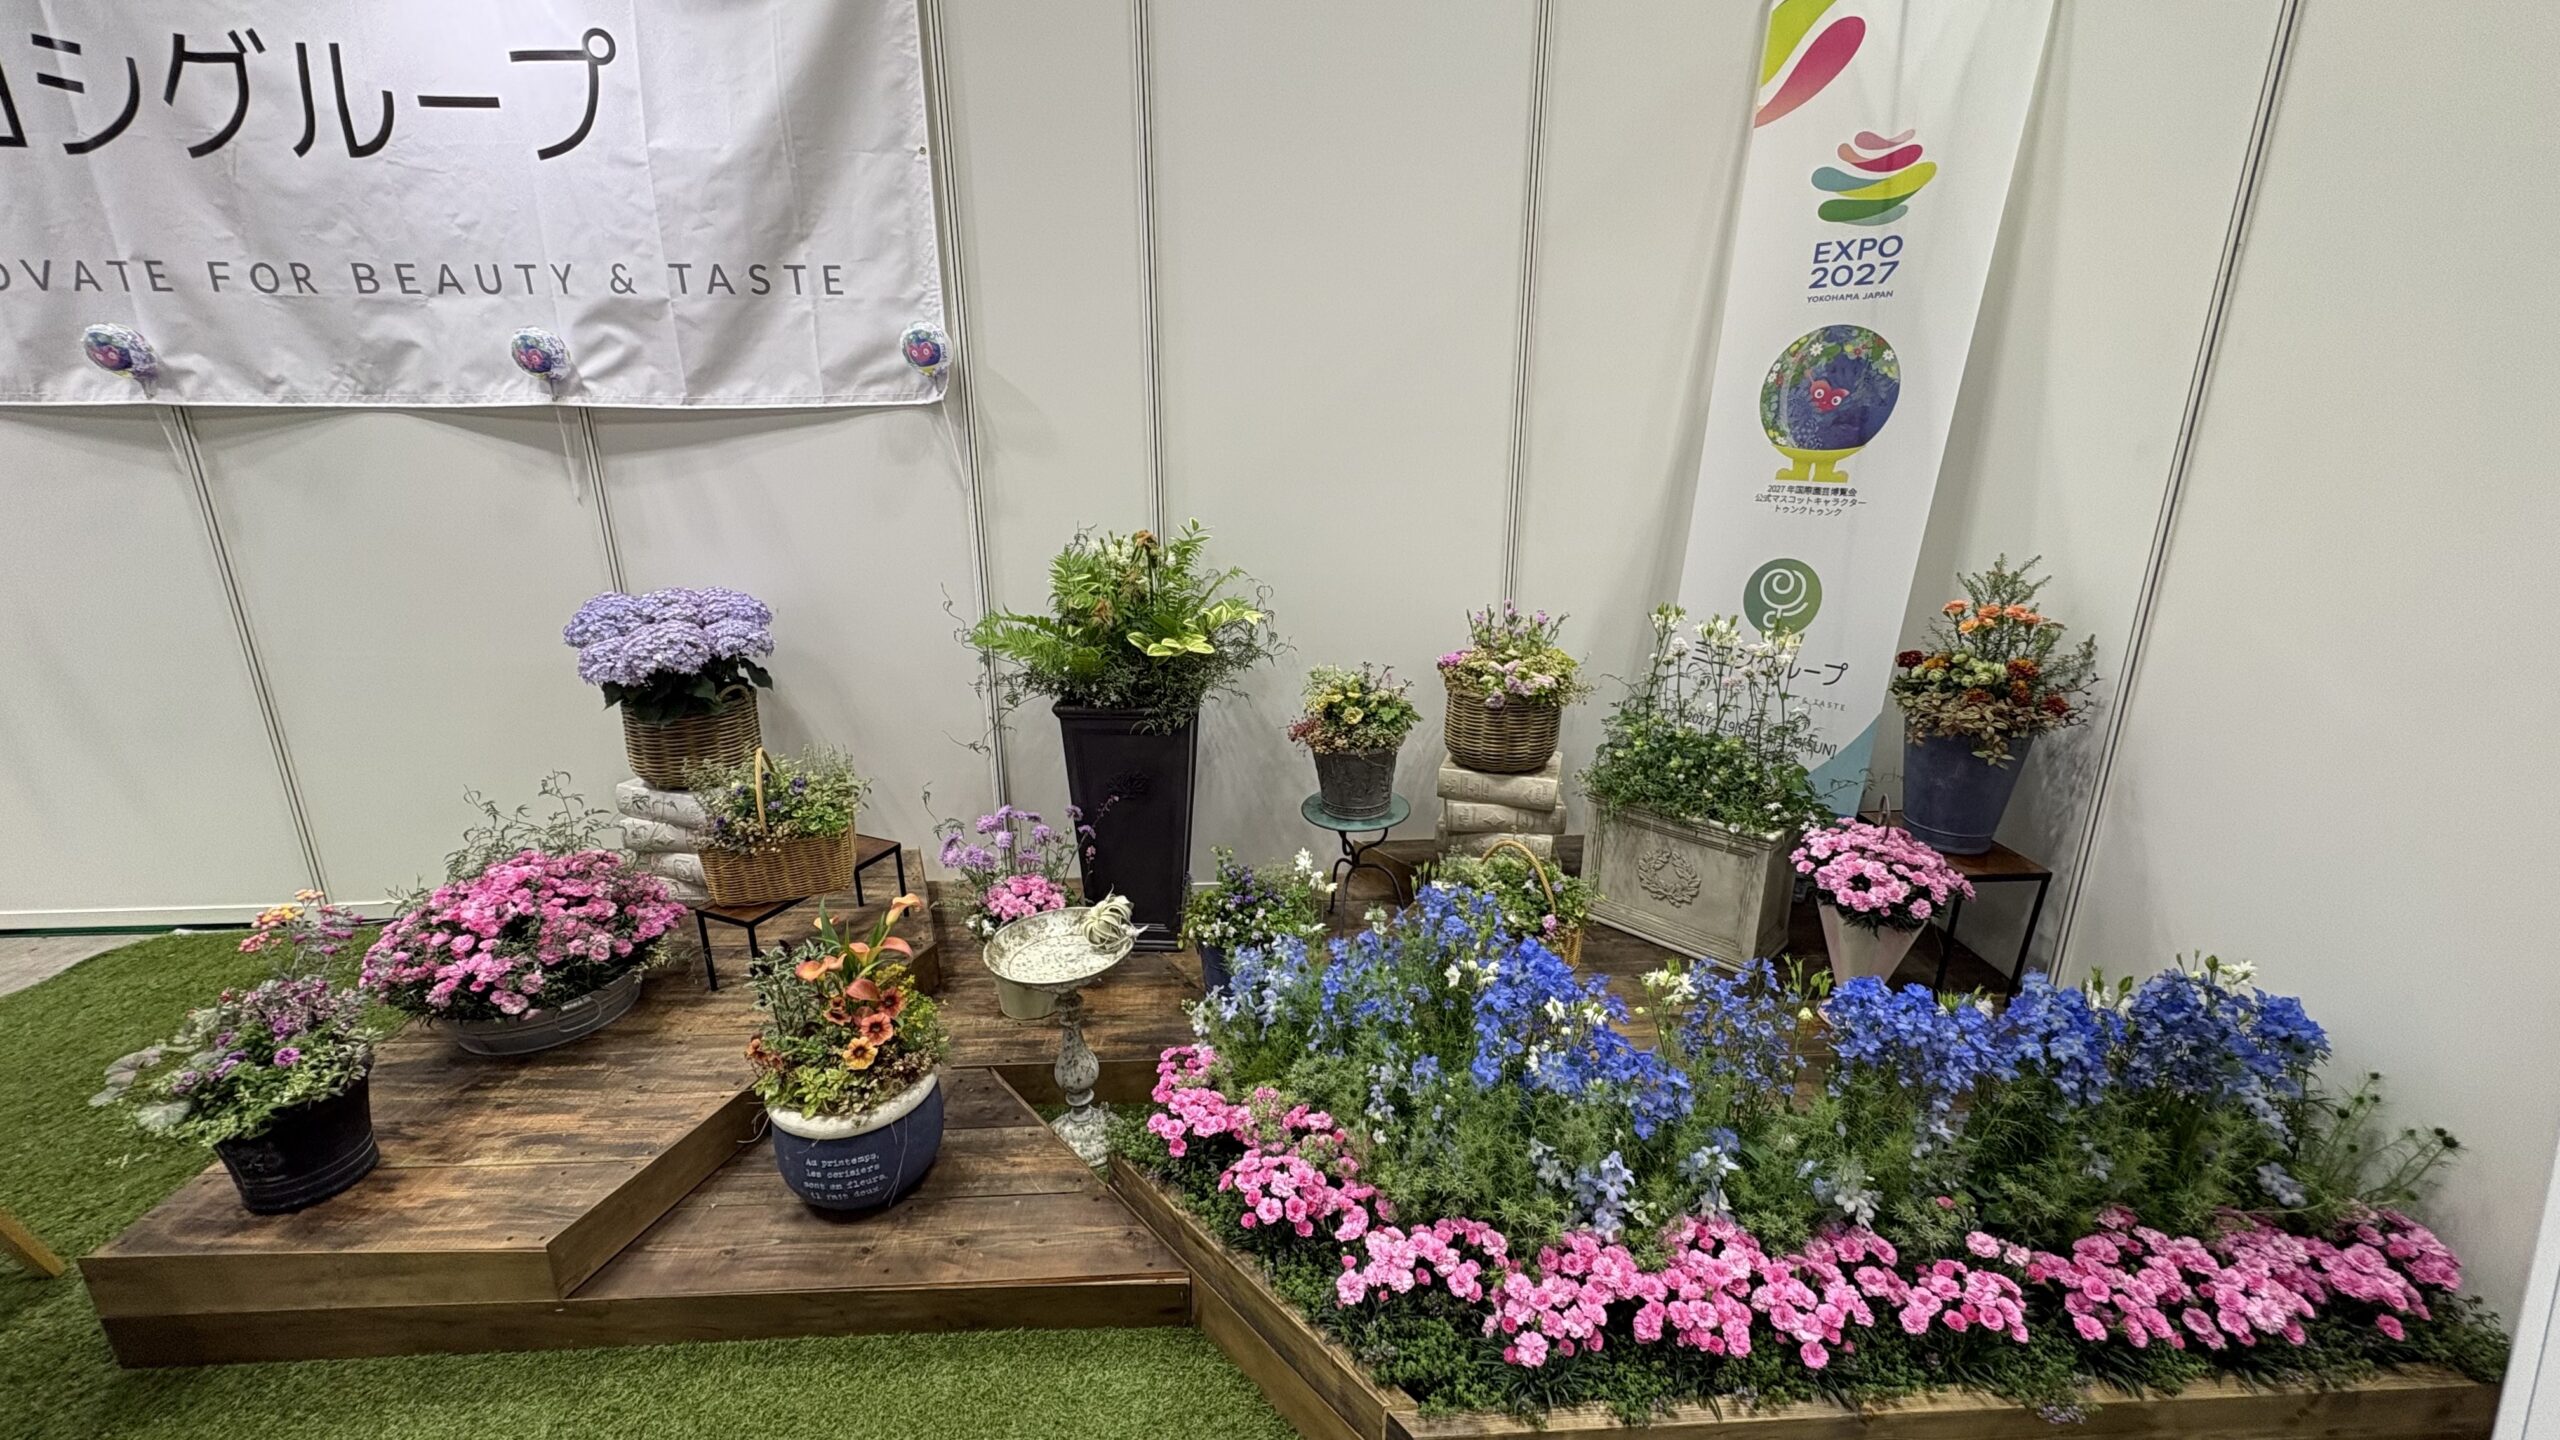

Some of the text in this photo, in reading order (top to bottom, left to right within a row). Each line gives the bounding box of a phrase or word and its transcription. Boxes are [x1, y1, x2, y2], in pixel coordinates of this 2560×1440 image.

[1813, 235, 1903, 264] EXPO
[207, 261, 319, 294] FOR
[351, 262, 572, 296] BEAUTY
[610, 263, 637, 295] &
[668, 263, 844, 296] TASTE
[1808, 260, 1899, 289] 2027
[1807, 290, 1893, 303] YOKOHAMA JAPAN
[1755, 494, 1867, 507] 公式マスコットキャラクター
[1775, 504, 1842, 516] トゥンクトゥンク
